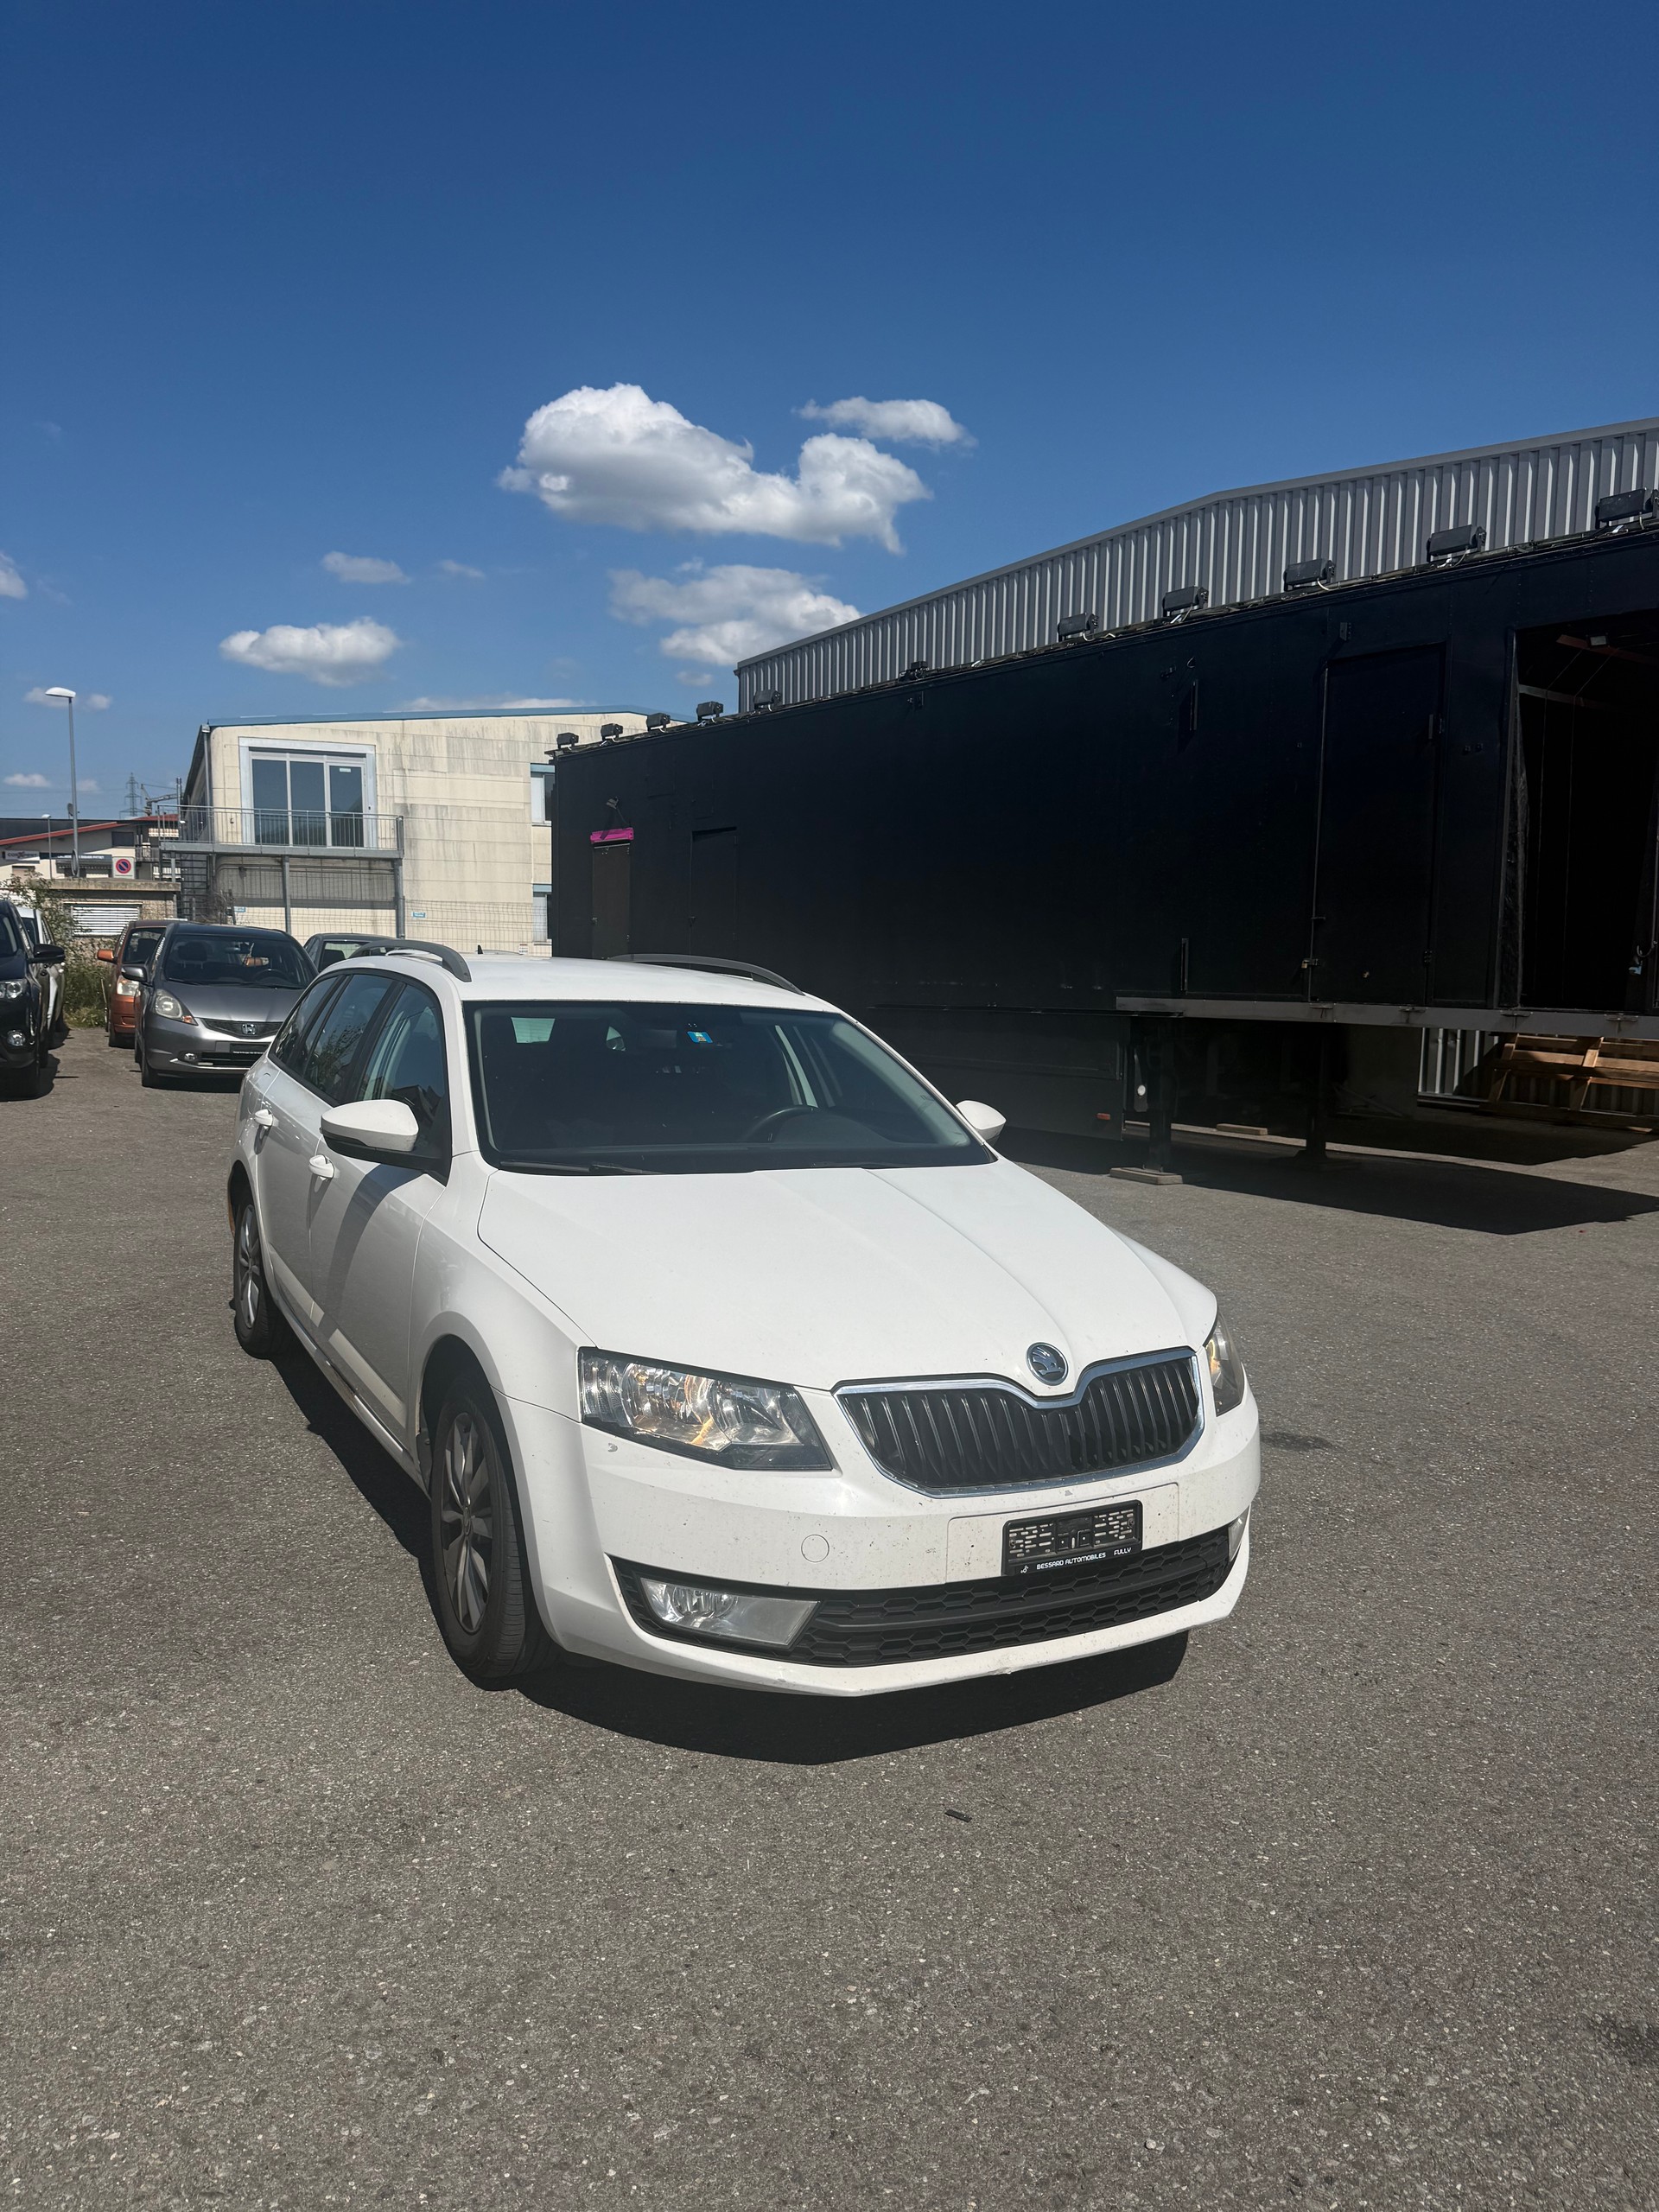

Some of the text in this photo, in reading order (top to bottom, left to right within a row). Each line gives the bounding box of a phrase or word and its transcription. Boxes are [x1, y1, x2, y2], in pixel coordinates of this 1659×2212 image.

[1036, 1547, 1132, 1570] BESSARD AUTOMOBILES FULLY
